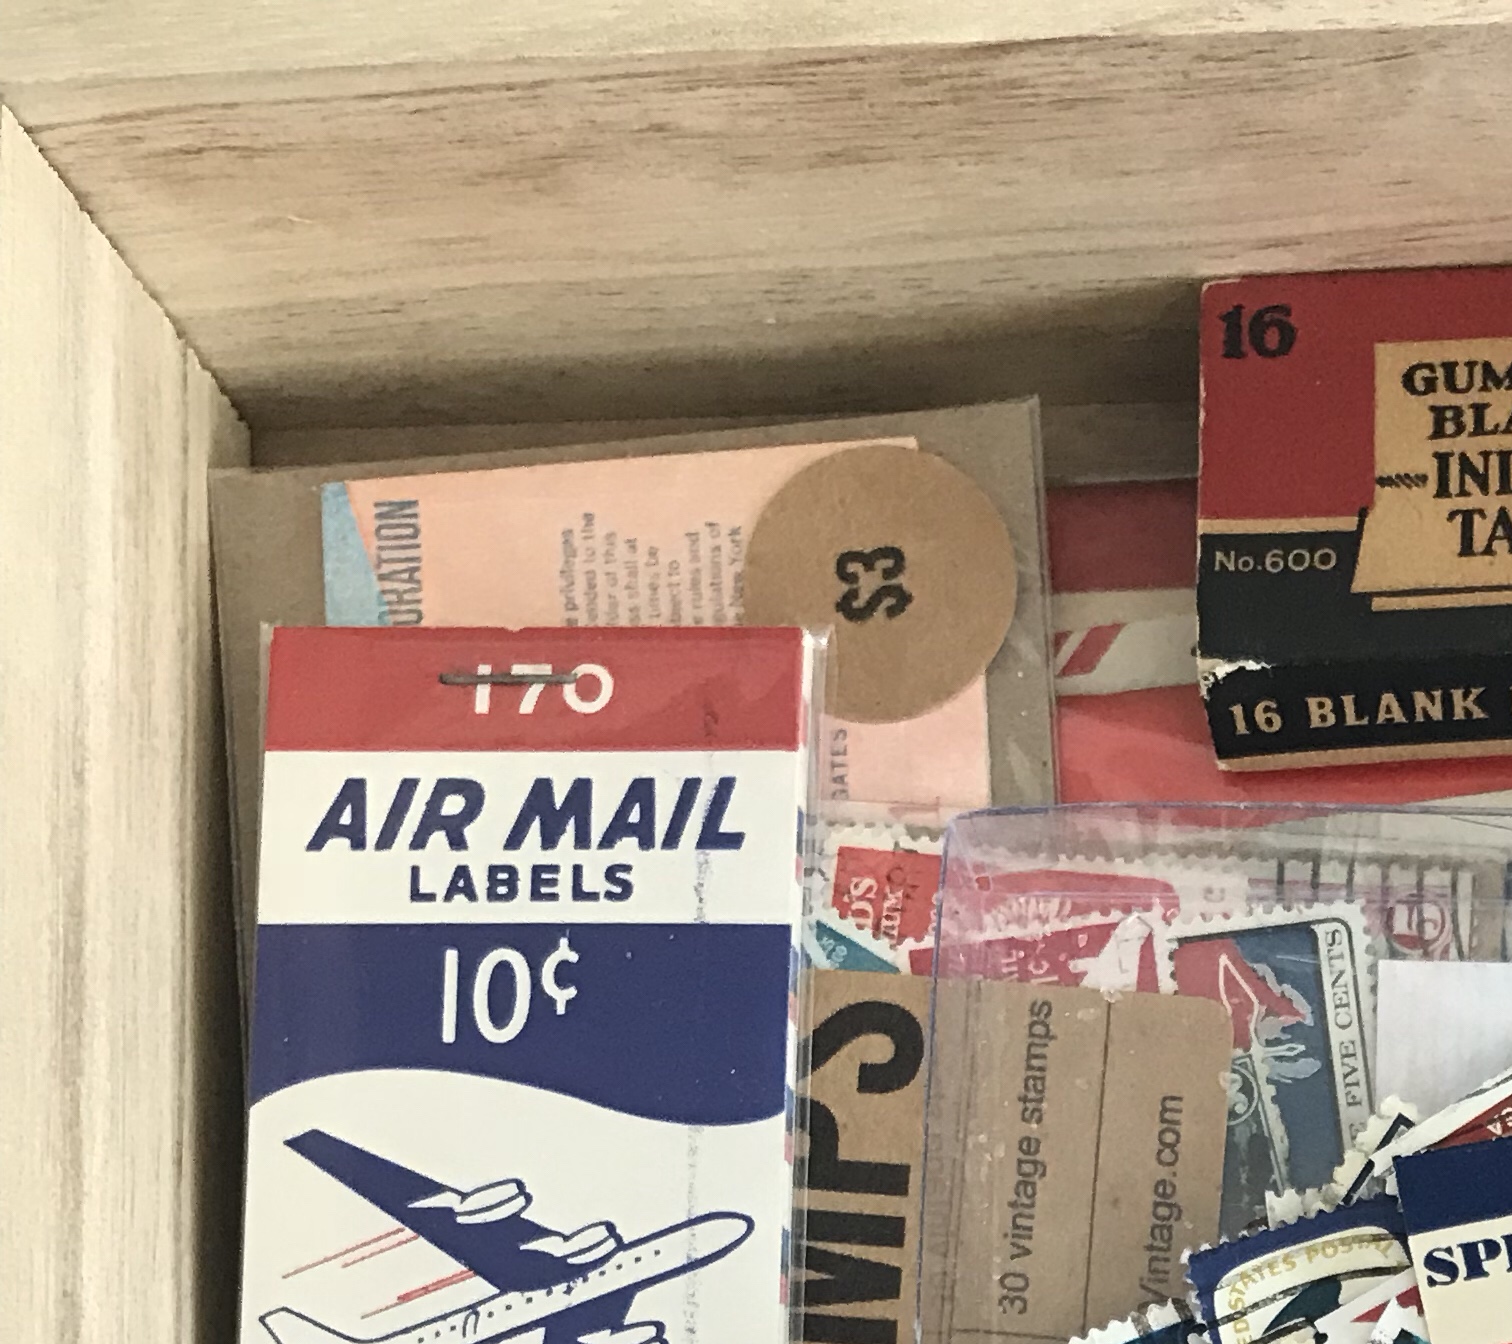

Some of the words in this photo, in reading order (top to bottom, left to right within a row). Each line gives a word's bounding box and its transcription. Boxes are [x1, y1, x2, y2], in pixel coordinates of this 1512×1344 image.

[1219, 304, 1297, 359] 16
[834, 544, 912, 624] $3
[471, 662, 615, 716] 170
[1228, 701, 1283, 736] 16
[1307, 685, 1490, 729] BLANK
[304, 776, 489, 852] AIR
[503, 776, 748, 852] MAIL
[409, 863, 635, 903] LABELS
[441, 928, 580, 1045] 10¢
[1324, 928, 1354, 1031] CENTS
[1018, 998, 1059, 1127] stamps
[1339, 1038, 1365, 1108] FIVE
[1009, 1132, 1049, 1262] vintage
[1001, 1272, 1030, 1316] 30
